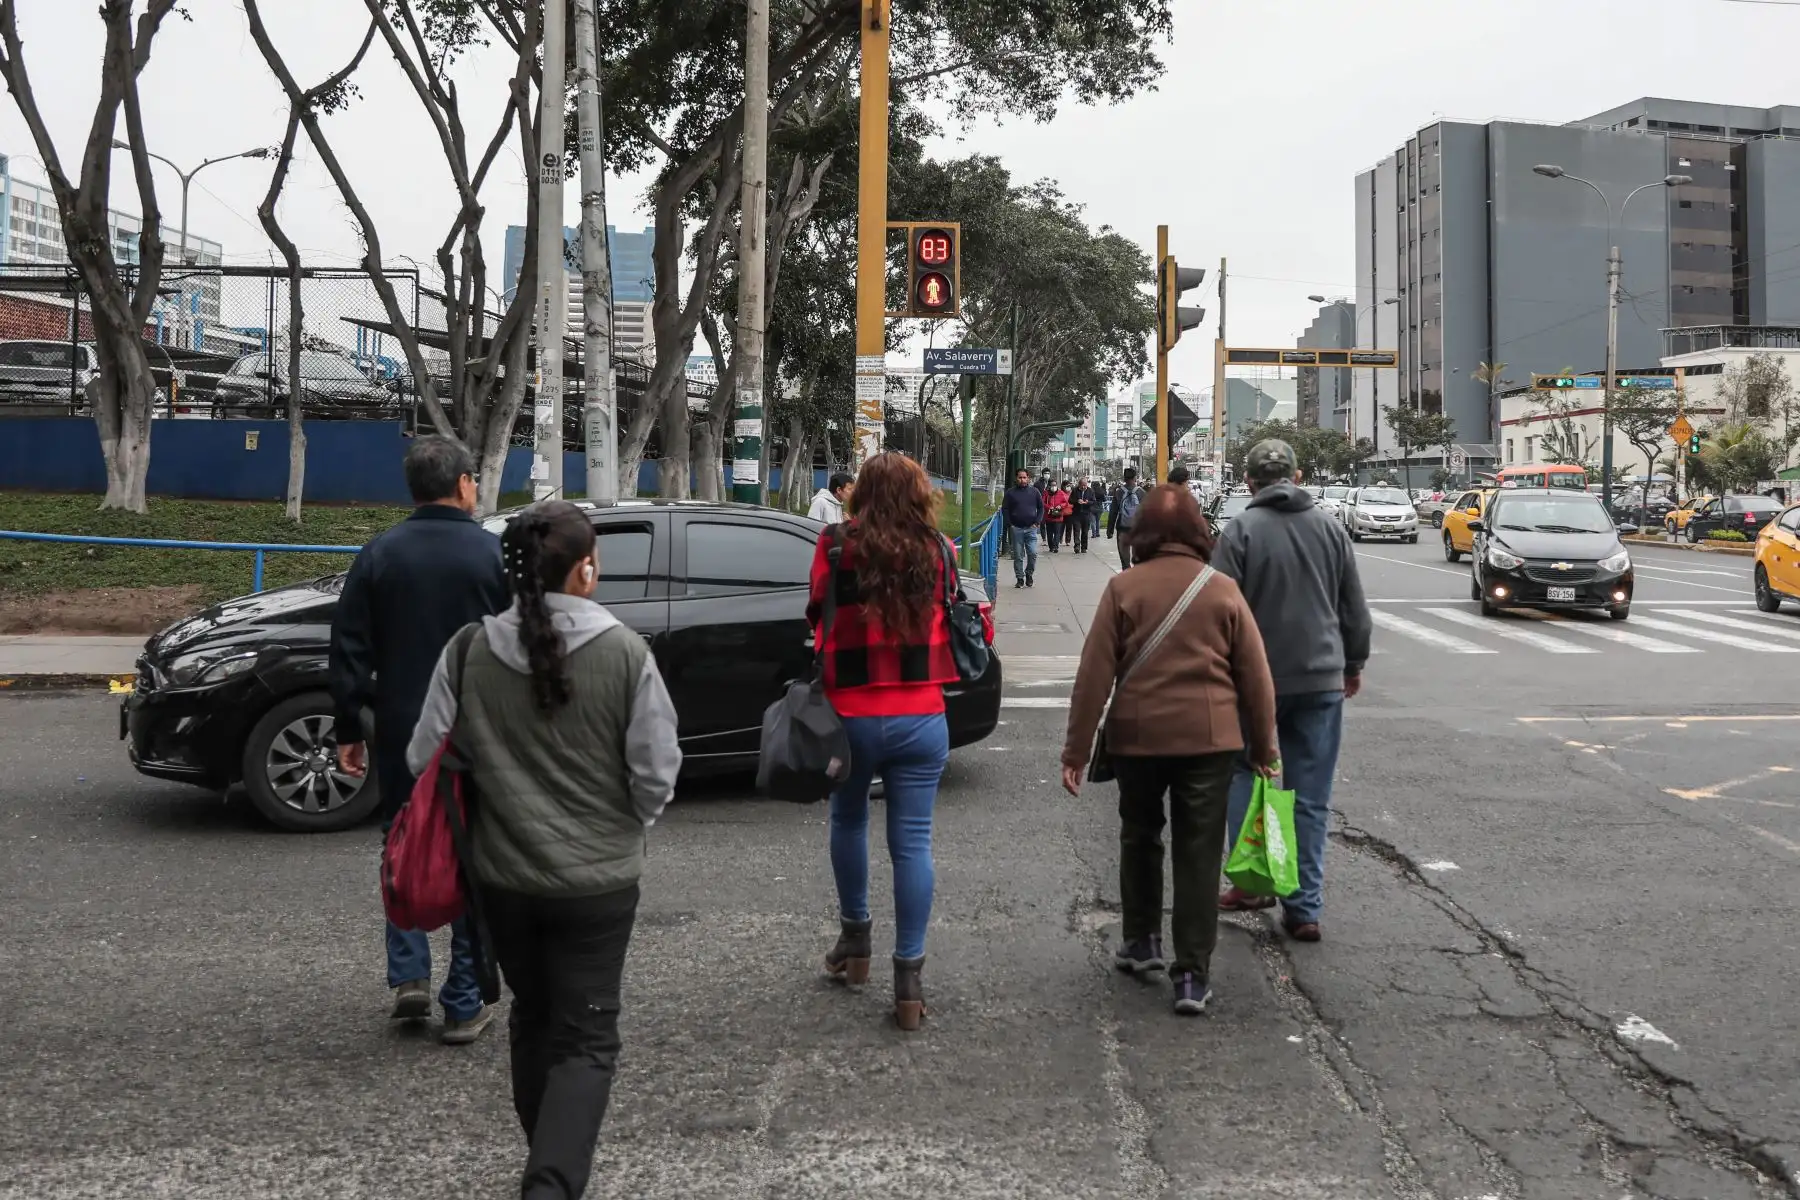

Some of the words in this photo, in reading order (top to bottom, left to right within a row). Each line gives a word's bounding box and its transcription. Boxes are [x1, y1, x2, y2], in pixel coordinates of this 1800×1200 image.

[922, 238, 947, 260] 83
[926, 351, 942, 360] Av.
[944, 351, 994, 363] Salaverry
